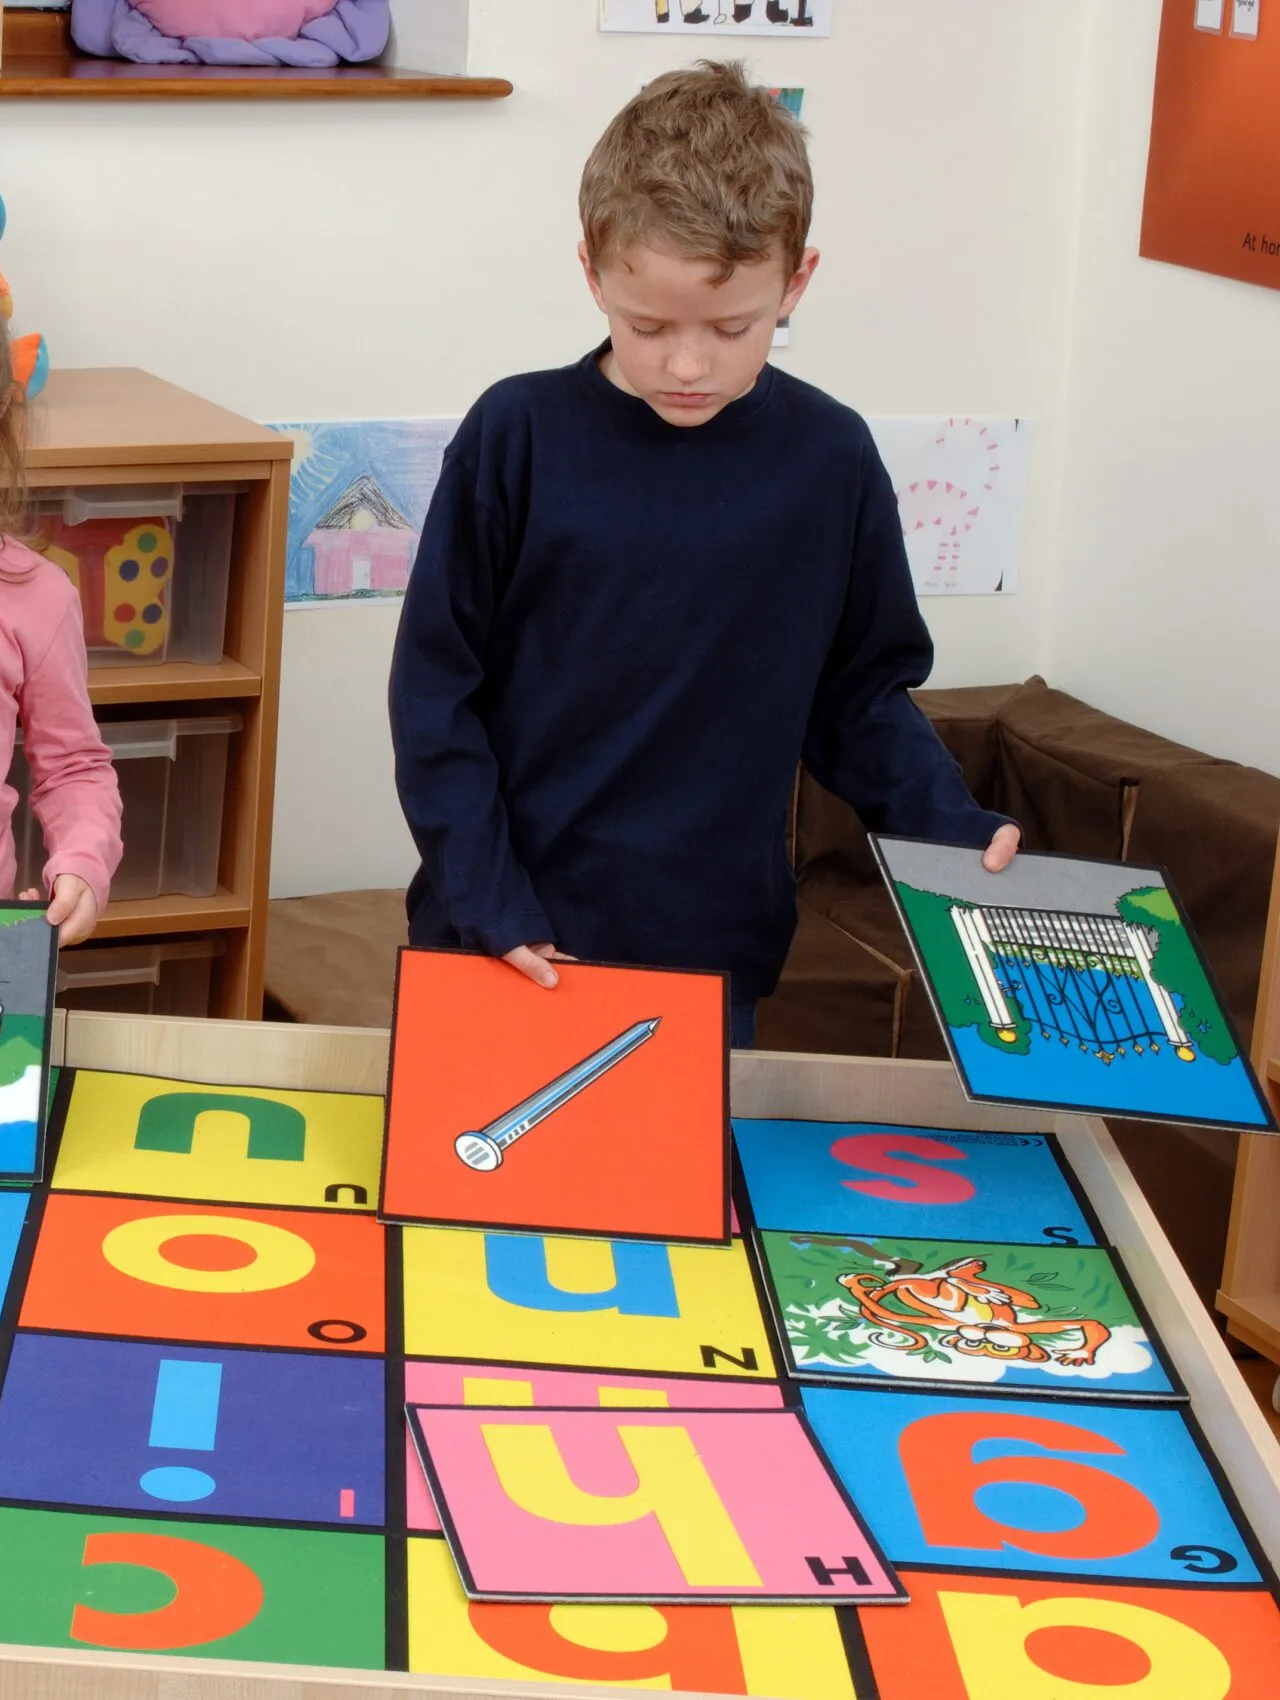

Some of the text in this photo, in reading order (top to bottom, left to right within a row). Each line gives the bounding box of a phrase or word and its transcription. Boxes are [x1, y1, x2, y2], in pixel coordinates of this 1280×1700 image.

[1242, 232, 1256, 251] At
[699, 1344, 759, 1371] N
[804, 1556, 873, 1586] H
[1170, 1544, 1238, 1574] G
